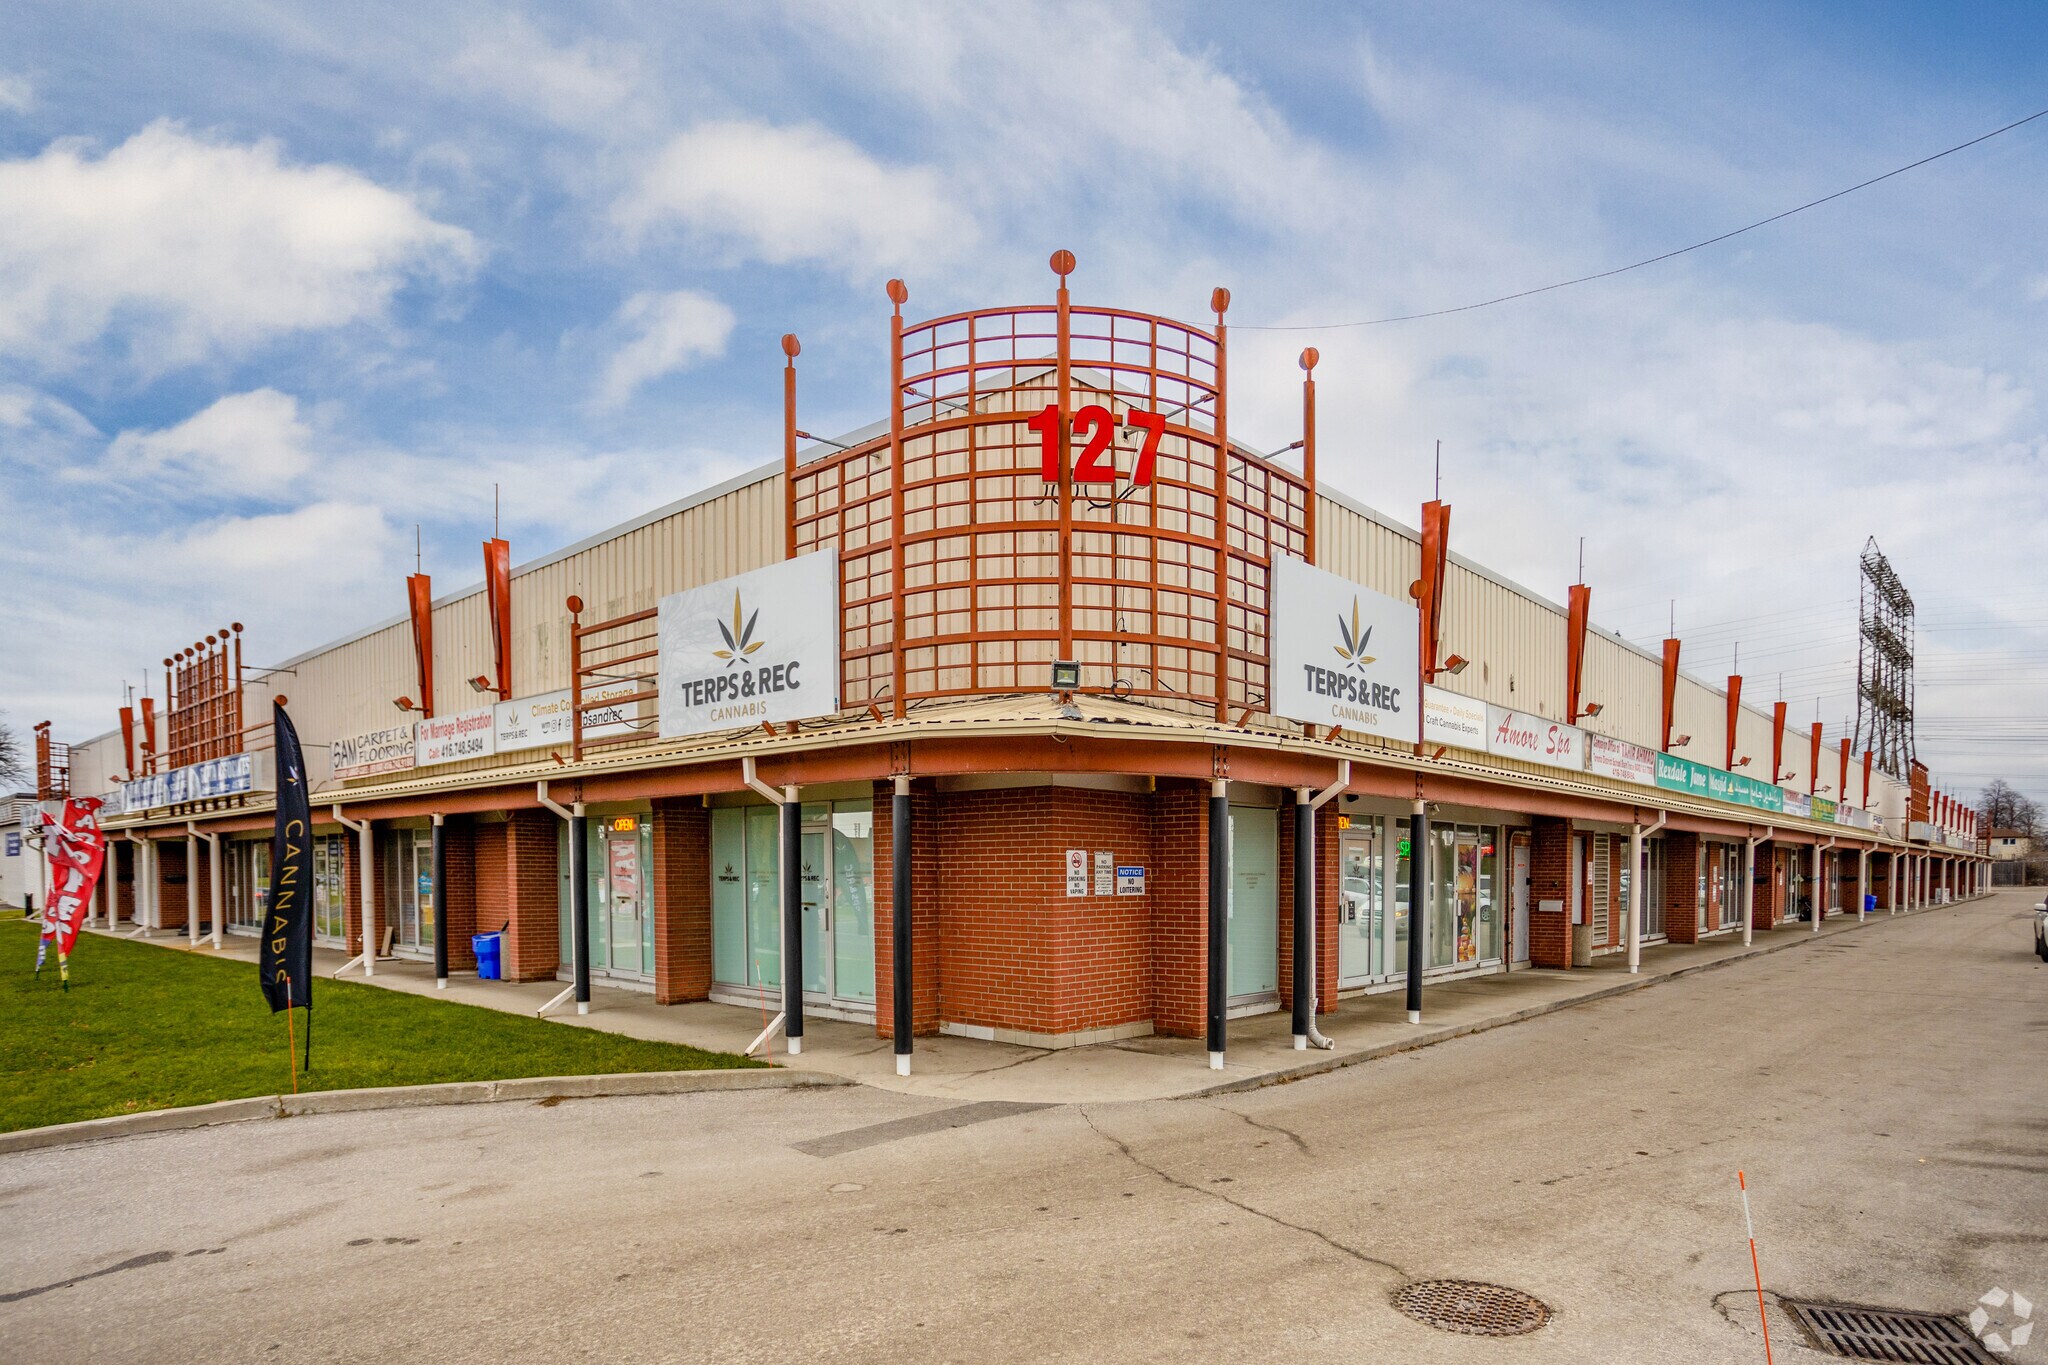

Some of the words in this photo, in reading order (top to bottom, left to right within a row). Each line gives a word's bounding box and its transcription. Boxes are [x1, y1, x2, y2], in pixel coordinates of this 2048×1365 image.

[1028, 404, 1166, 487] 127
[531, 703, 559, 718] Climate
[560, 692, 599, 712] Coolled
[710, 701, 767, 722] CANNABIS
[1331, 704, 1378, 725] CANNABIS
[420, 724, 429, 741] For
[430, 720, 455, 740] Marriage
[456, 711, 492, 737] Registration
[1425, 714, 1439, 726] Craft
[1439, 717, 1461, 731] Cannabis
[1461, 722, 1479, 735] Experts
[357, 727, 399, 749] CARPET
[400, 726, 408, 739] &
[441, 737, 483, 757] 416.748.5494
[1495, 713, 1538, 751] Amore
[1546, 725, 1570, 760] Spa
[333, 737, 357, 769] SAM
[359, 740, 414, 762] FLOORING
[1636, 747, 1655, 765] AHMAD
[1658, 758, 1687, 782] Rexdale
[1708, 773, 1727, 797] Masjid
[614, 818, 634, 832] OPEN
[1338, 815, 1350, 829] PEN
[1119, 886, 1143, 894] LOITERING
[271, 819, 304, 984] CANNABIS
